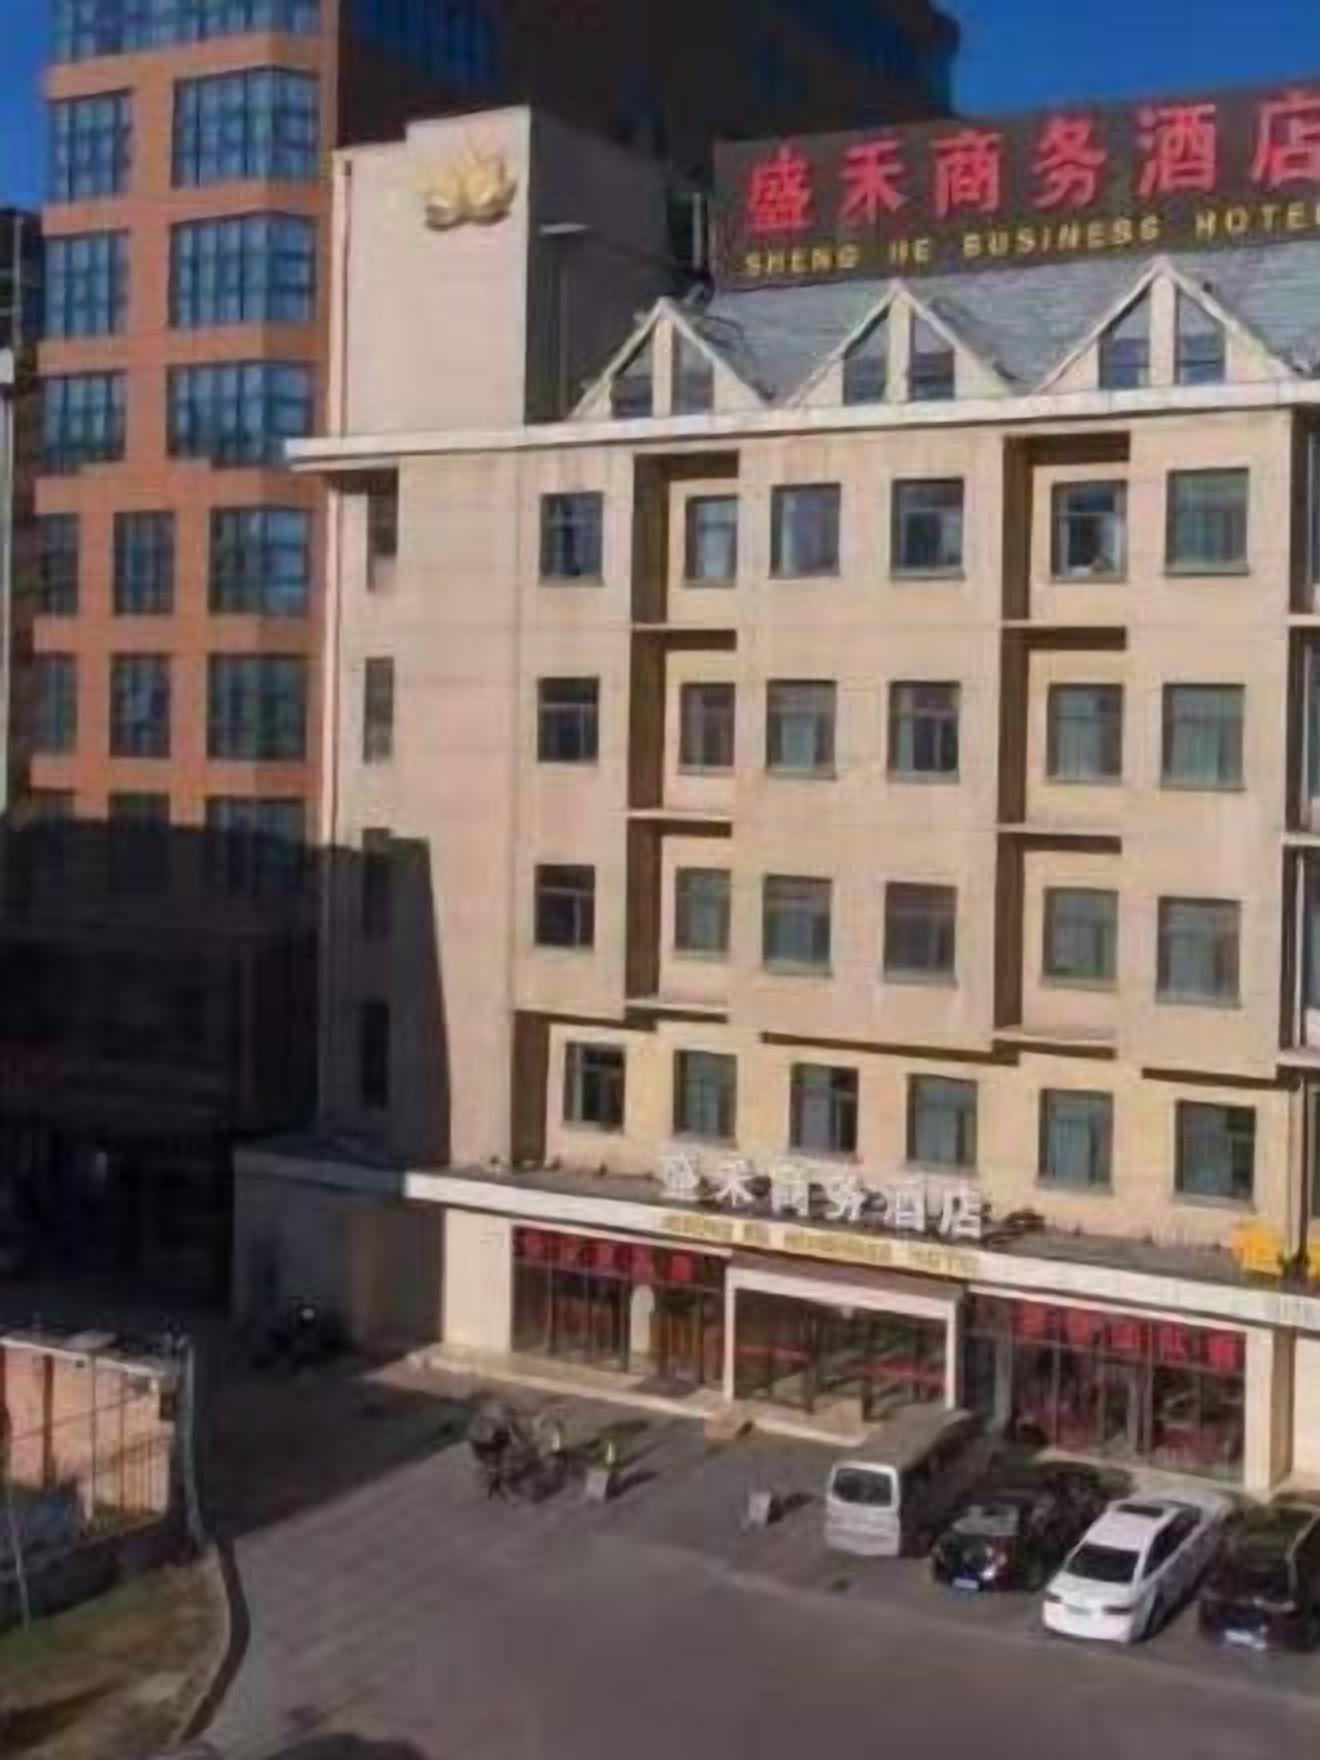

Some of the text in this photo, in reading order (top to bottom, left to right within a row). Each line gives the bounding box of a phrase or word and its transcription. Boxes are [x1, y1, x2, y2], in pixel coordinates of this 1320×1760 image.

[744, 243, 861, 278] SHENG
[888, 237, 932, 267] HE
[961, 212, 1162, 259] BUSINESS
